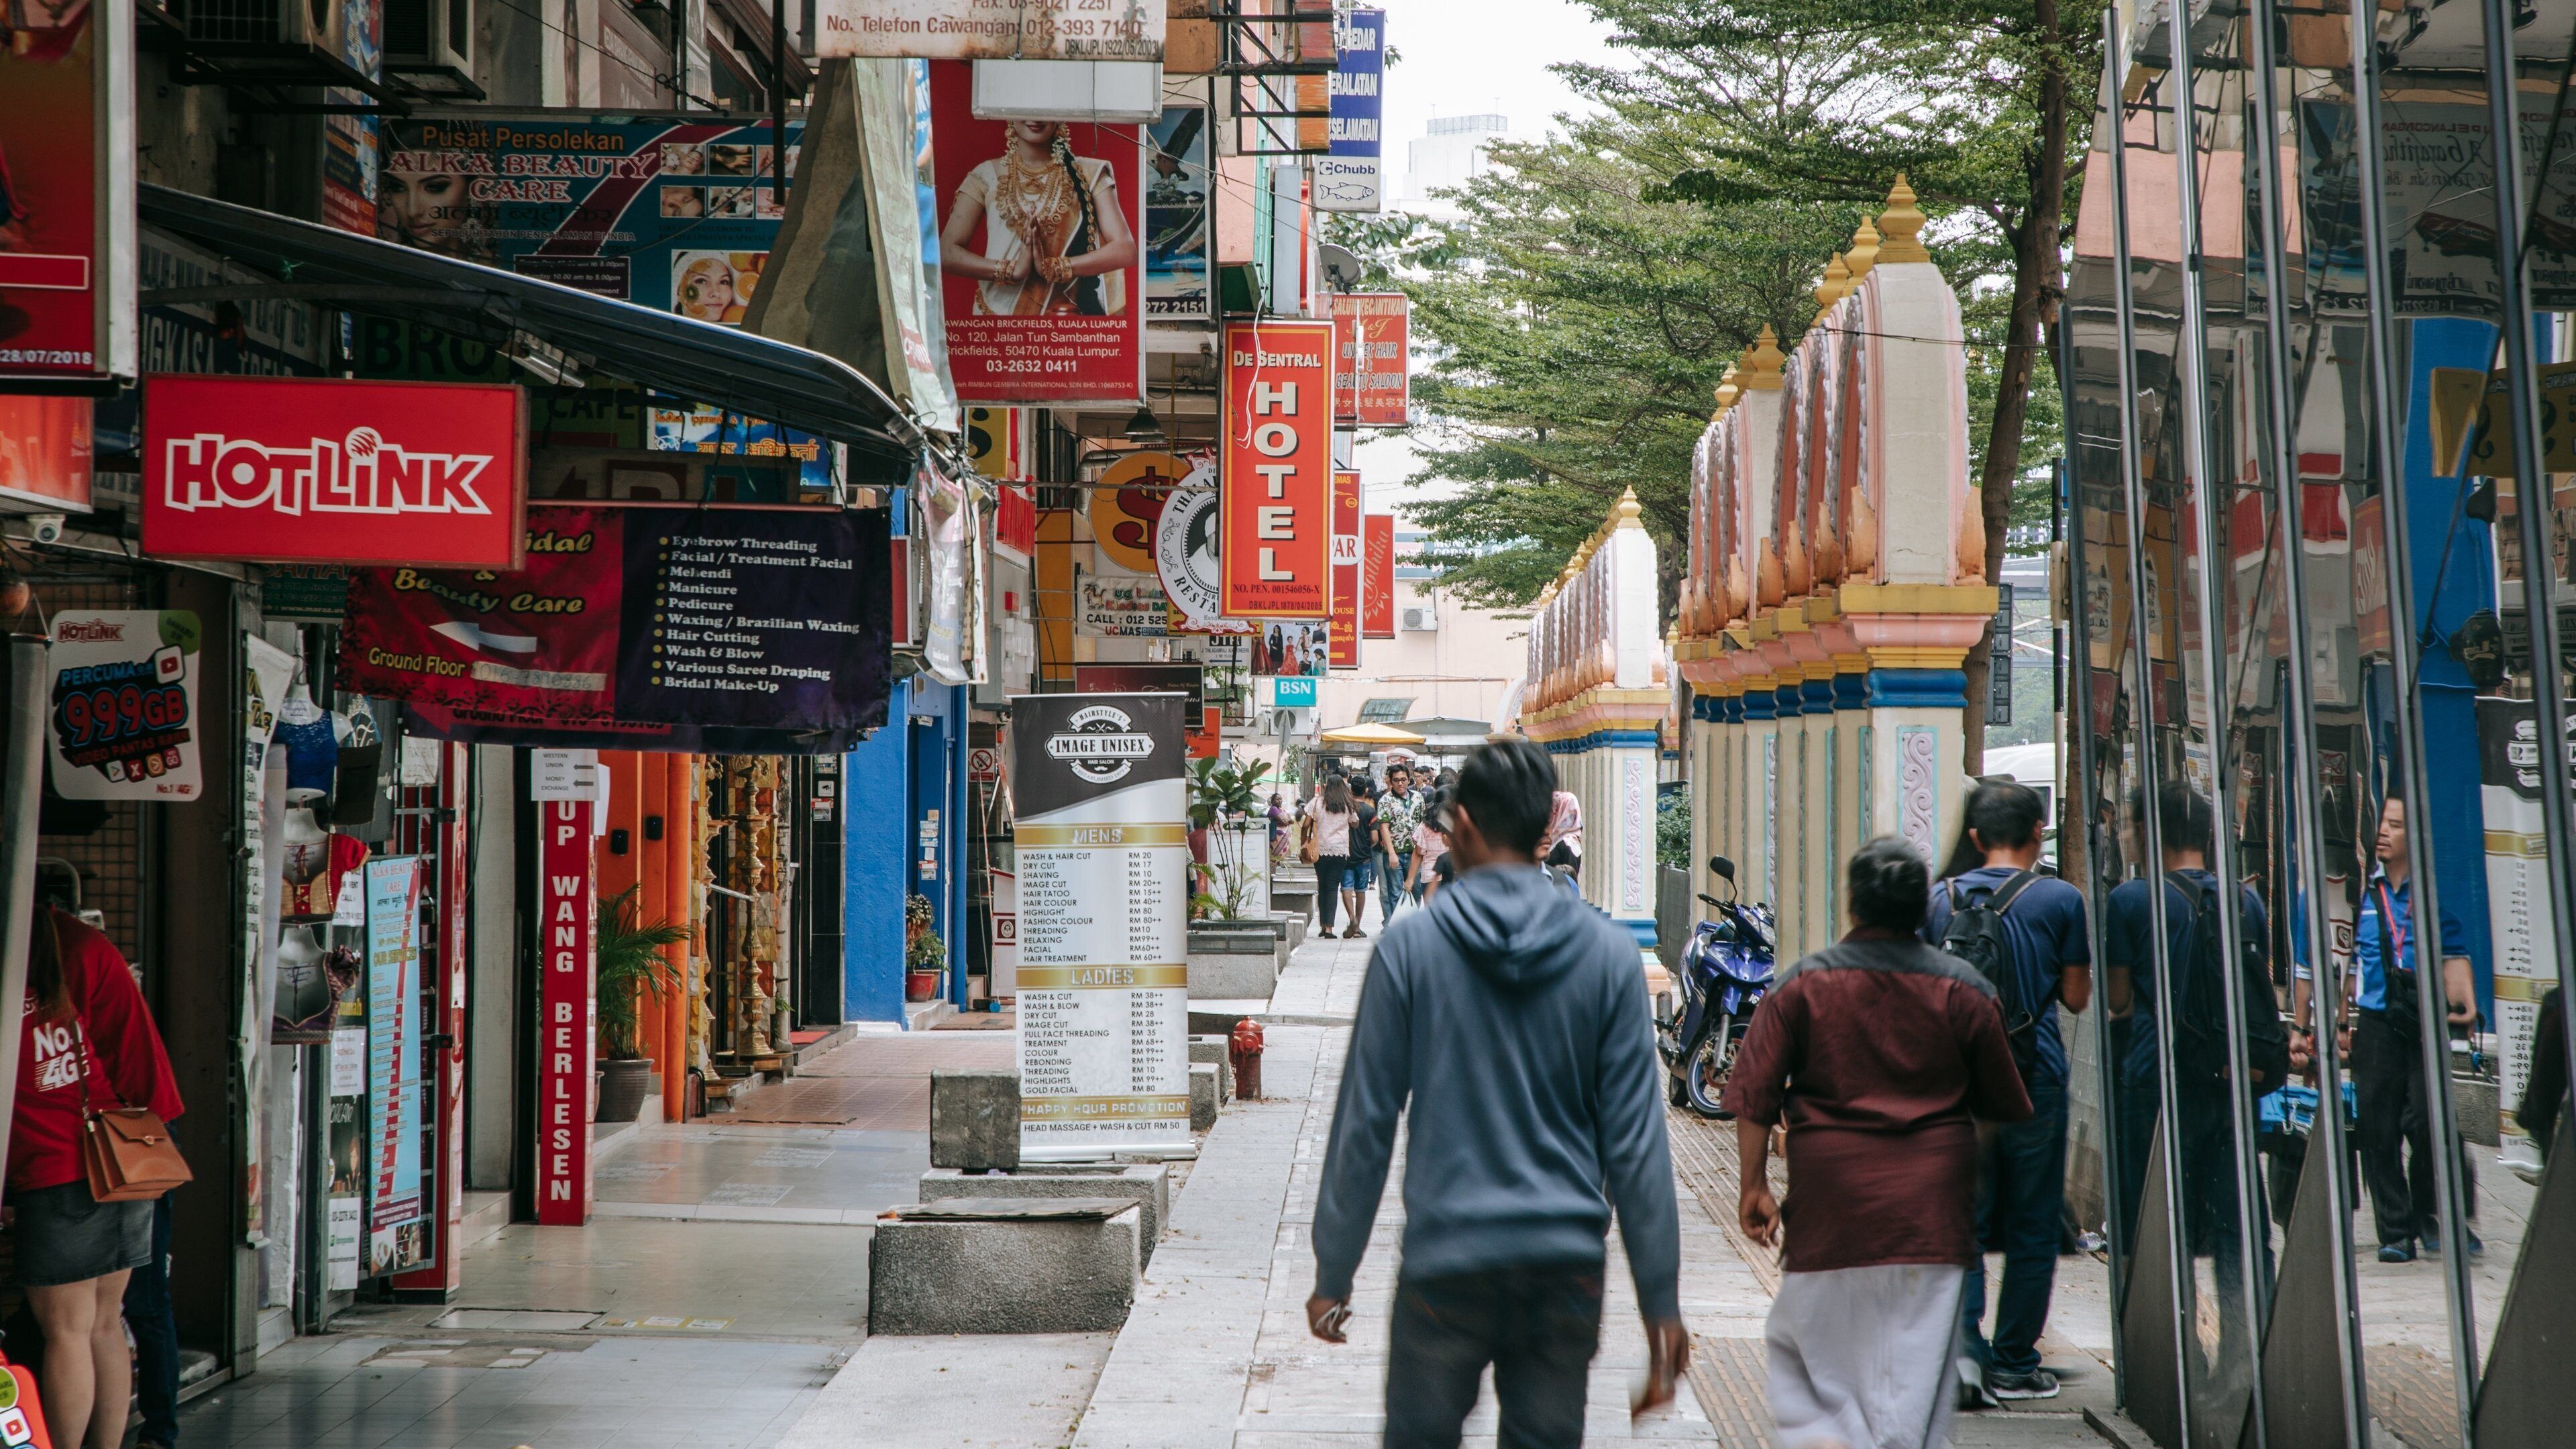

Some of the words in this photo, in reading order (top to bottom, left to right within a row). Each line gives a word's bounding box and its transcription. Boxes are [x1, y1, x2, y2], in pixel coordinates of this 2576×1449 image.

[827, 15, 855, 33] No.
[860, 15, 920, 33] Telefon
[927, 17, 1020, 36] Cawangan:
[1026, 19, 1094, 36] 012-393
[1102, 19, 1142, 36] 7140
[1331, 72, 1377, 96] ERALATAN
[423, 125, 488, 148] Pusat
[495, 126, 625, 151] Persolekan
[1330, 117, 1379, 141] SELAMATAN
[382, 152, 497, 176] ALKA
[500, 152, 657, 179] BEAUTY
[1334, 163, 1376, 175] Chubb
[469, 178, 573, 203] CARE
[481, 229, 518, 239] TAHUN
[520, 230, 592, 241] PENGALAMAN
[606, 232, 636, 241] INDIA
[1145, 301, 1170, 313] 272
[1173, 300, 1205, 313] 2151
[945, 319, 994, 329] AWANGAN
[997, 319, 1055, 331] BRICKFIELDS,
[1058, 319, 1087, 329] KUALA
[1090, 319, 1127, 329] LUMPUR
[946, 331, 962, 342] No.
[968, 332, 990, 344] 120,
[994, 331, 1023, 343] Jalan
[1026, 331, 1046, 343] Tun
[1051, 331, 1121, 343] Sambanthan
[1, 347, 93, 365] 28/07/2018
[946, 345, 1002, 358] Brickfields,
[1006, 345, 1039, 356] 50470
[1043, 345, 1075, 357] Kuala
[1077, 345, 1122, 359] Lumpur.
[1342, 342, 1375, 360] UNEX
[1375, 341, 1397, 360] HAIR
[986, 360, 1041, 372] 03-2632
[1046, 360, 1077, 373] 0411
[1256, 352, 1322, 369] SENTRAL
[1369, 372, 1404, 390] SALOON
[1254, 381, 1299, 582] HOTEL
[525, 530, 594, 553] idal
[672, 535, 737, 549] Eyebrow
[741, 537, 818, 554] Threading
[1332, 539, 1356, 557] AR
[671, 550, 714, 564] Facial
[716, 552, 725, 566] /
[728, 552, 806, 567] Treatment
[810, 556, 853, 571] Facial
[669, 566, 731, 580] Mehendi
[394, 568, 500, 613] Beauty
[508, 592, 584, 613] Care
[669, 582, 737, 595] Manicure
[1173, 576, 1218, 613] RESTA
[1233, 583, 1249, 594] NO.
[1250, 584, 1270, 594] PEN.
[1272, 584, 1320, 594] 001546056-X
[668, 597, 734, 611] Pedicure
[1334, 606, 1354, 615] OUSE
[667, 613, 724, 629] Waxing
[725, 616, 733, 629] /
[737, 616, 804, 631] Brazilian
[806, 619, 860, 635] Waxing
[1087, 614, 1115, 625] CALL
[1126, 615, 1146, 626] 012
[666, 629, 700, 641] Hair
[703, 631, 760, 647] Cutting
[1142, 627, 1167, 637] BRICKF
[666, 644, 706, 657] Wash
[709, 647, 723, 657] &
[725, 646, 765, 659] Blow
[368, 647, 422, 672] Ground
[425, 655, 466, 677] Floor
[665, 660, 724, 674] Various
[727, 663, 767, 676] Saree
[770, 665, 831, 682] Draping
[664, 676, 711, 689] Bridal
[714, 678, 780, 694] Make-Up
[1279, 681, 1311, 695] BSN
[1055, 739, 1096, 753] IMAGE
[1102, 739, 1145, 753] UNISEX
[556, 800, 573, 847] UP
[1073, 828, 1123, 844] MENS
[551, 875, 580, 974] WANG
[1070, 967, 1134, 985] LADIES
[550, 1002, 574, 1202] BERLESEN
[1049, 1123, 1090, 1131] MASSAGE
